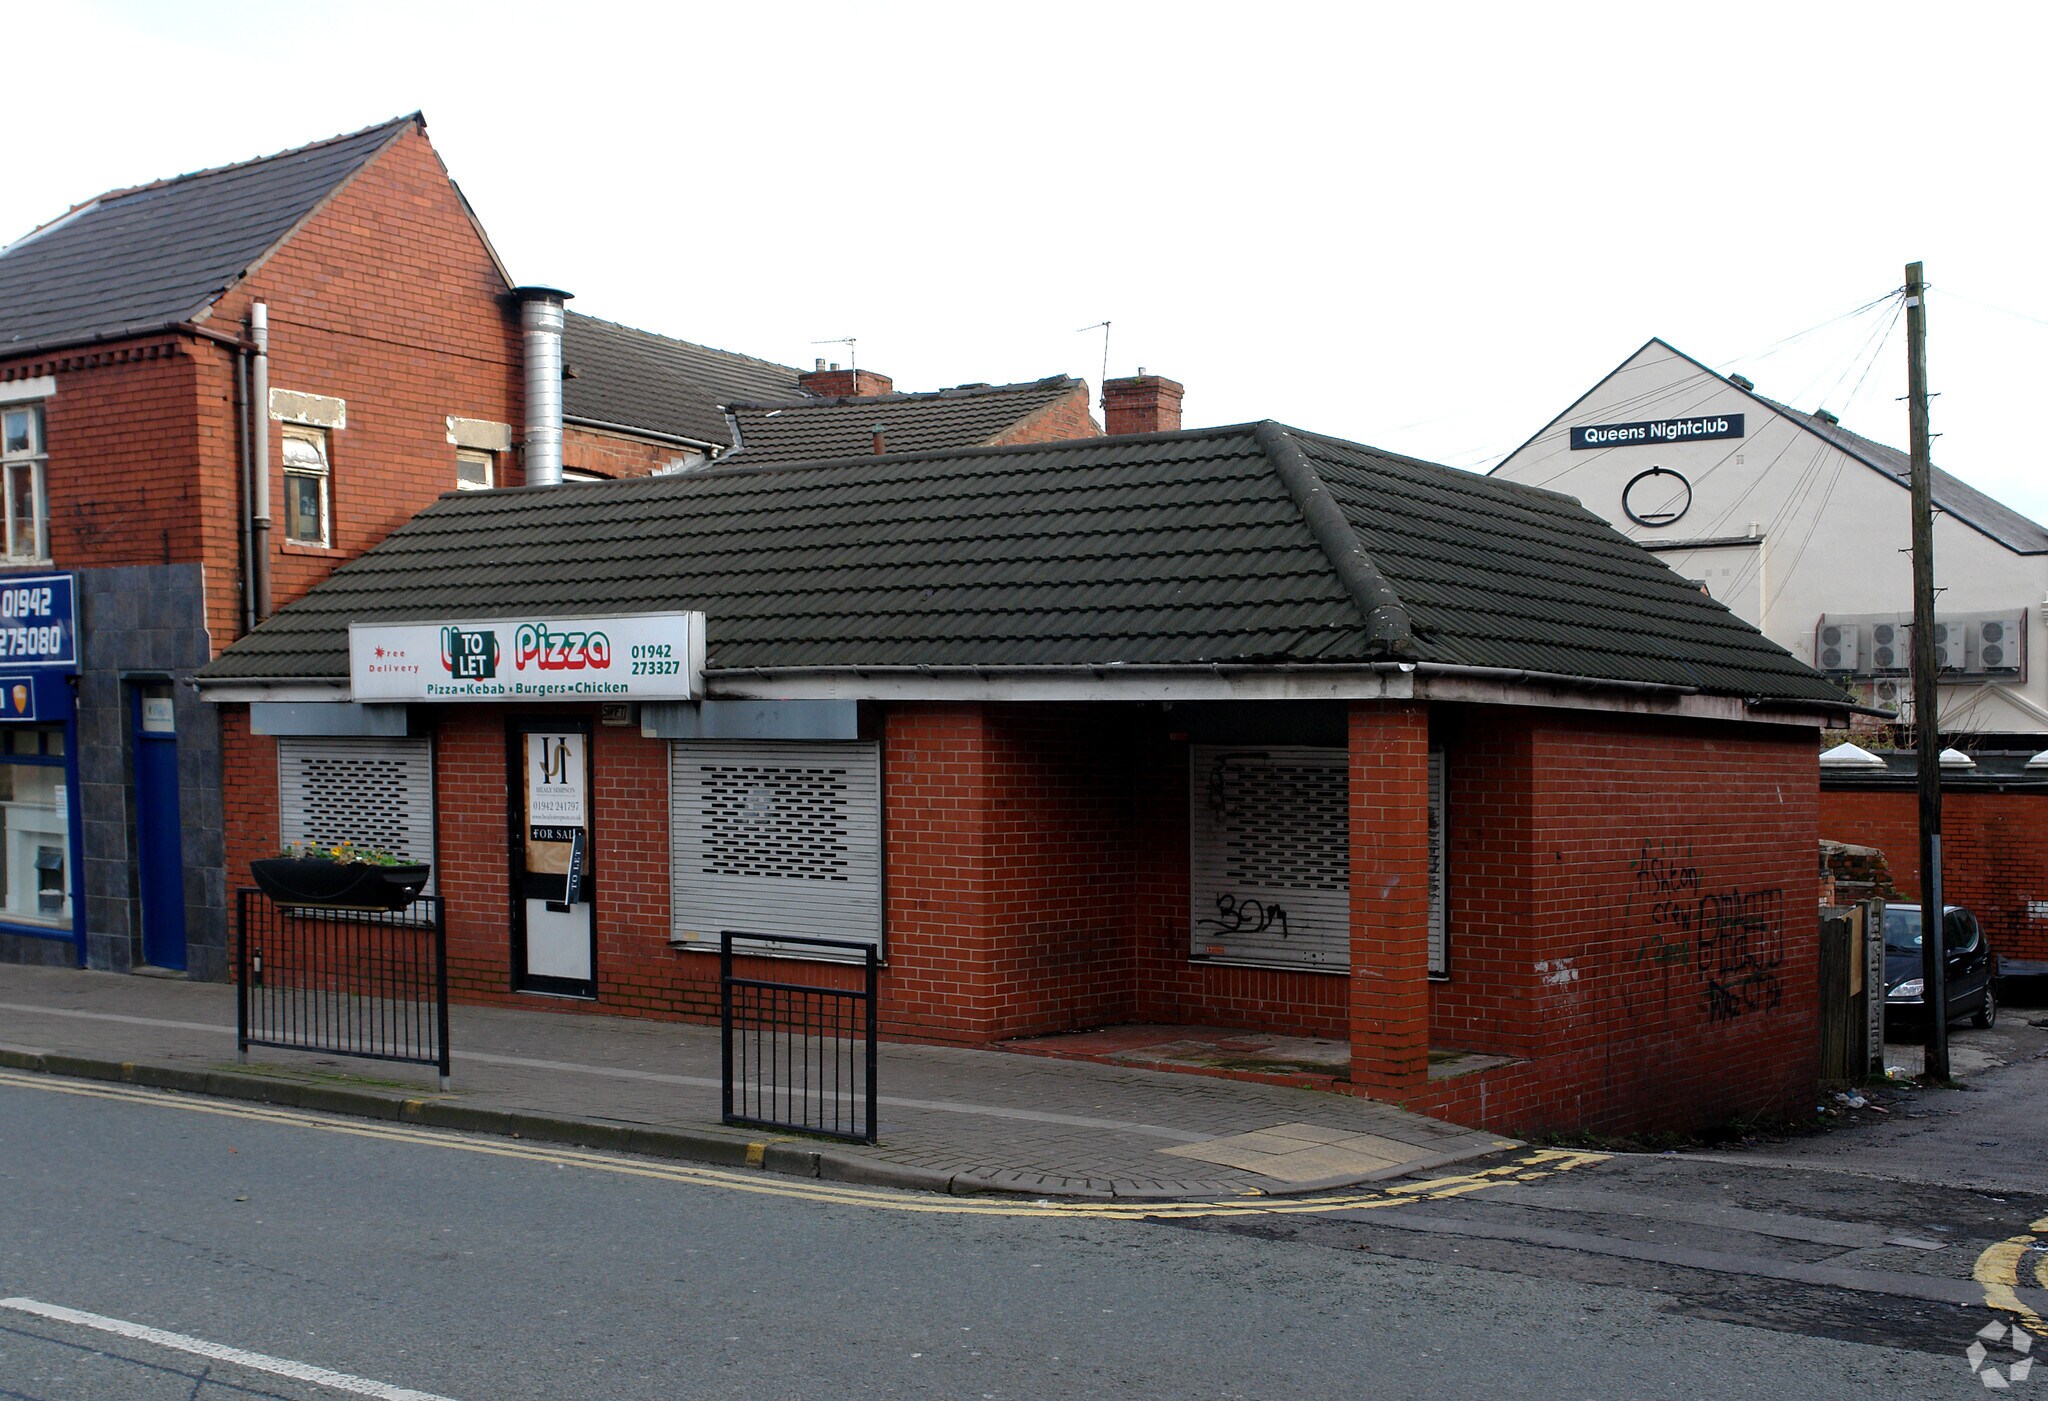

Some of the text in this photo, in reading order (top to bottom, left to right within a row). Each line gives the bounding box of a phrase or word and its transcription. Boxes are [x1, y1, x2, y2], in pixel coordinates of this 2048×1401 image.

[1585, 418, 1729, 443] Queens Nightclub
[2, 588, 52, 617] 01942
[0, 626, 61, 656] 275080
[461, 634, 483, 654] TO
[515, 622, 611, 671] Pizza
[631, 644, 672, 659] 01942
[369, 664, 419, 674] Delivery
[459, 655, 487, 675] LET
[631, 661, 680, 675] 273327
[427, 681, 629, 697] Pizza Kebab Burgers Chicken
[532, 801, 579, 811] 01942 241797
[534, 828, 574, 840] FOR SAL
[570, 850, 581, 890] TO LET
